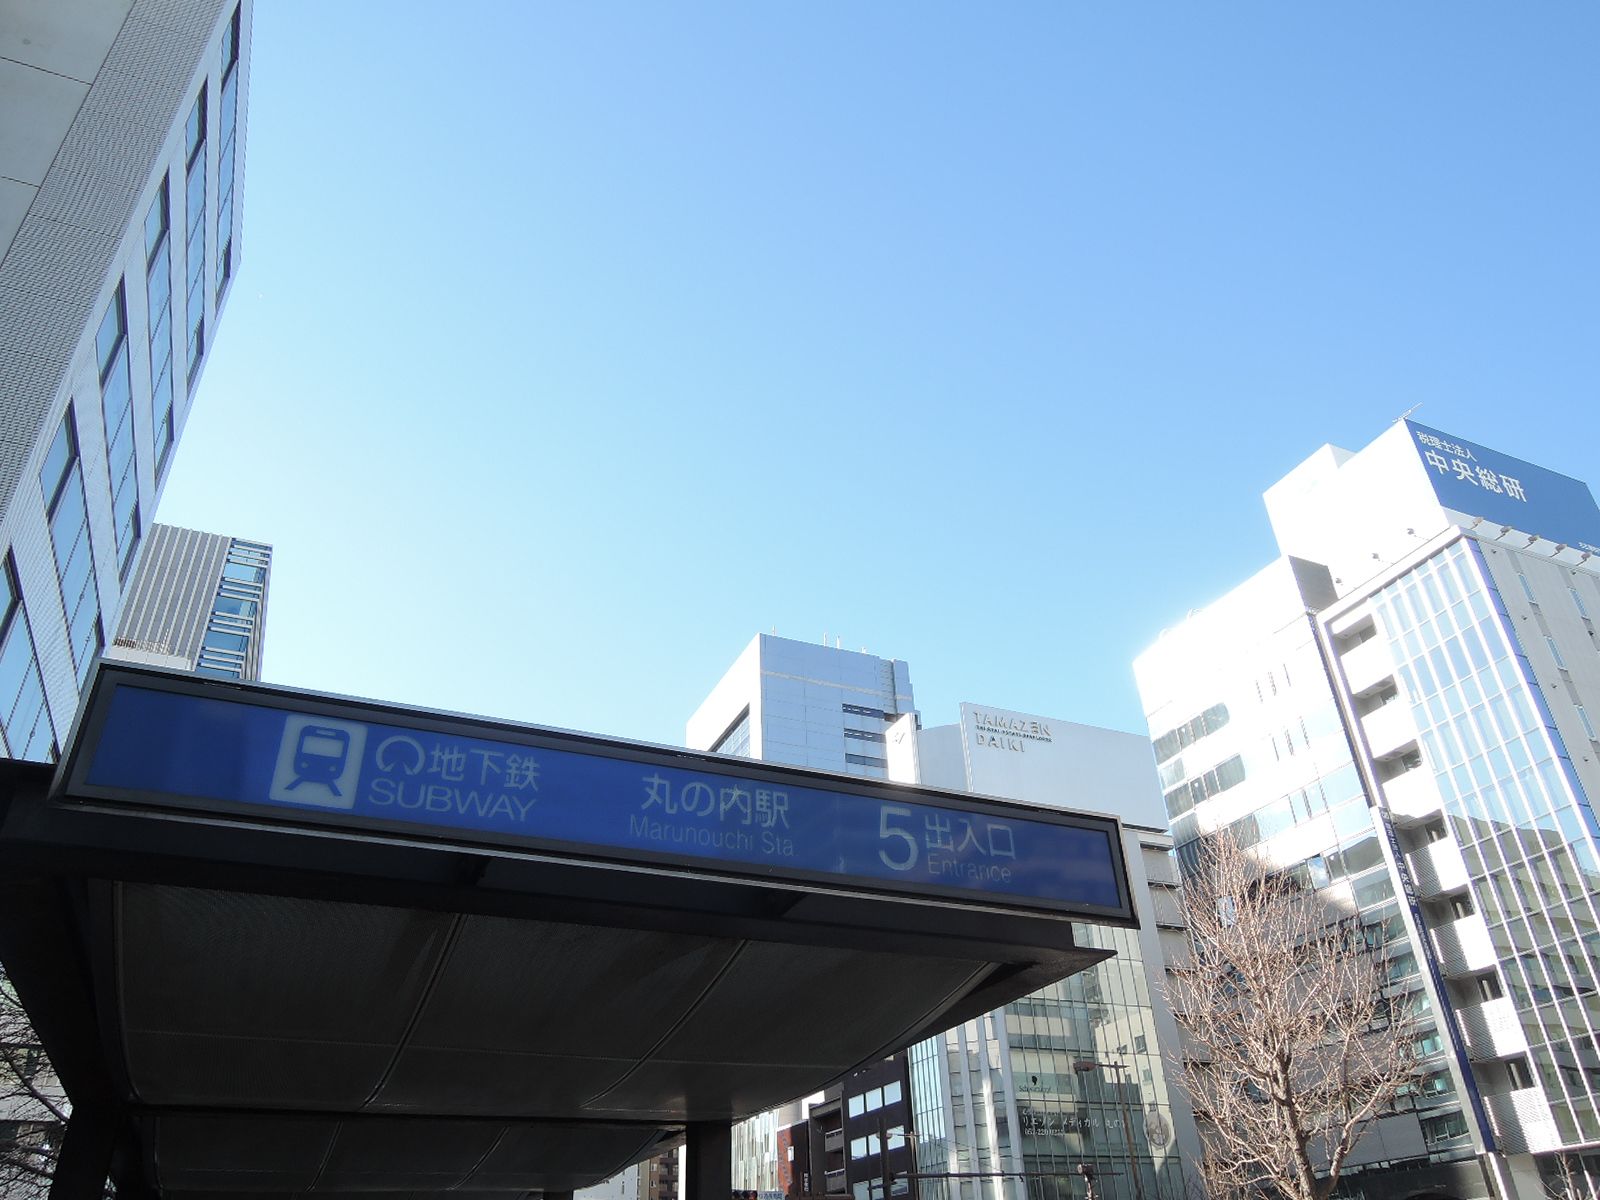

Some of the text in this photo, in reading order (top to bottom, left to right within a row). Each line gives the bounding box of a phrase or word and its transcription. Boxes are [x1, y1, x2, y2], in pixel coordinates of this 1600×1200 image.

[1416, 430, 1477, 463] 税理士法人
[1425, 449, 1527, 503] 中央総研
[974, 712, 1051, 736] TAMAZEN
[975, 732, 1025, 753] DAIKI
[427, 744, 541, 793] 地下鉄
[368, 777, 537, 822] SUBWAY
[641, 772, 791, 829] 丸の内駅
[629, 814, 754, 850] Marunouchi
[878, 804, 920, 871] 5
[924, 813, 1017, 860] 出入口
[928, 853, 1011, 883] Entrance
